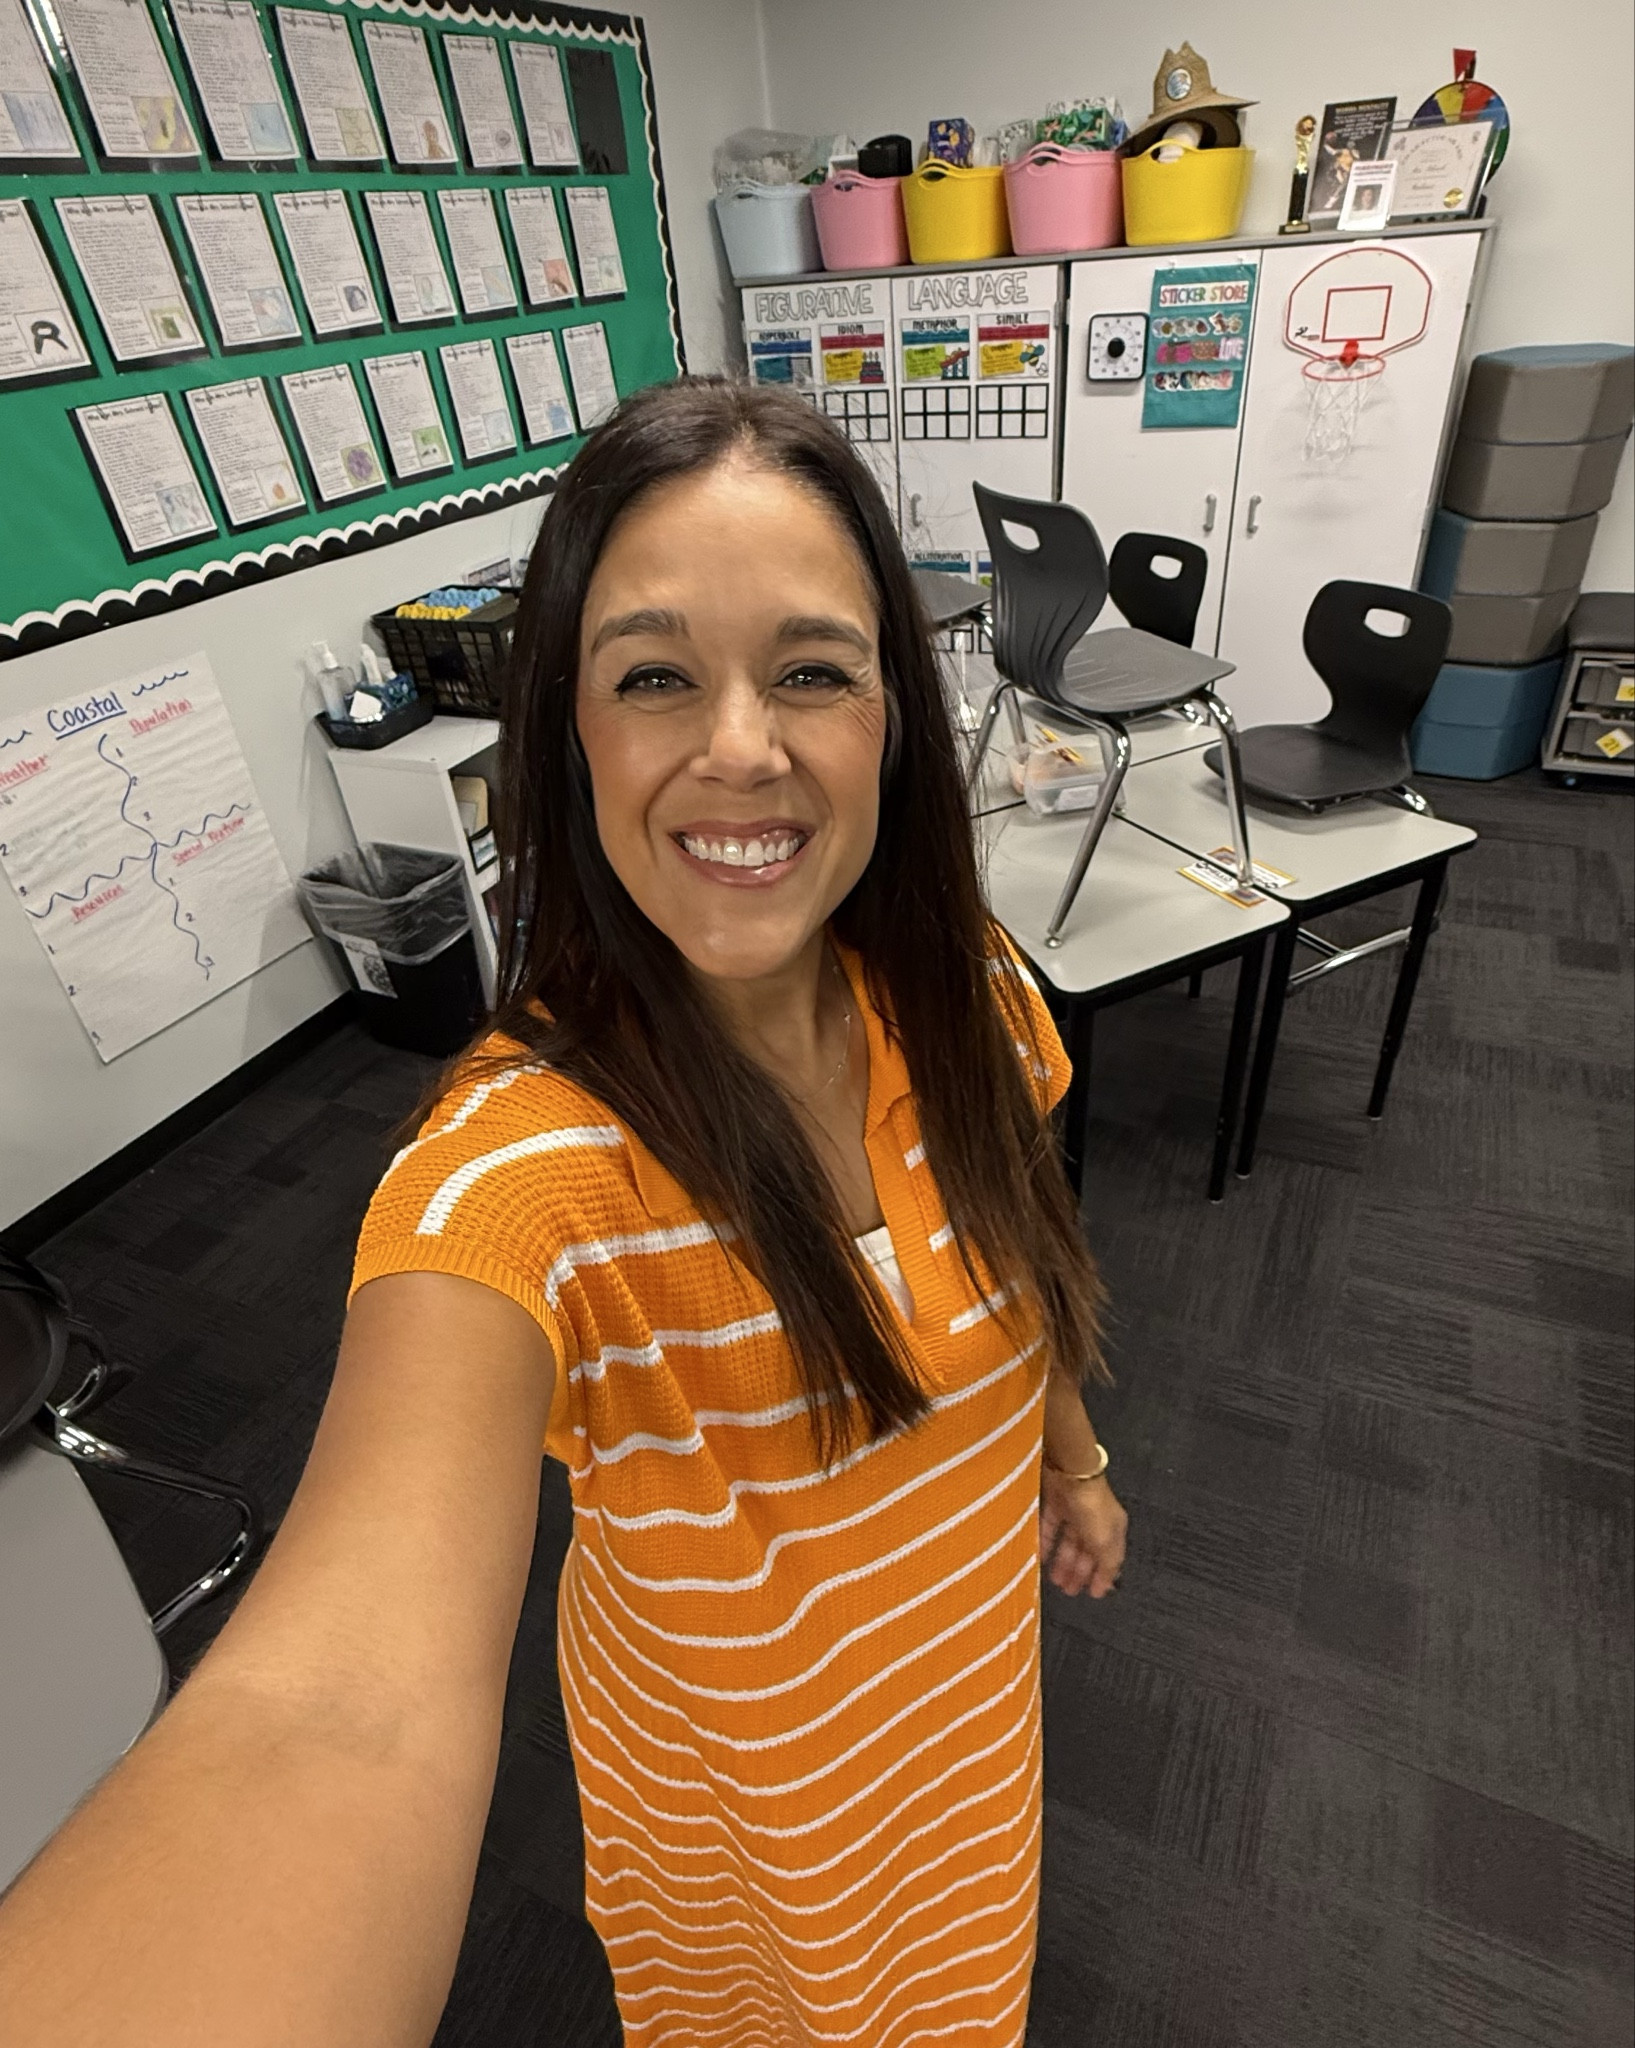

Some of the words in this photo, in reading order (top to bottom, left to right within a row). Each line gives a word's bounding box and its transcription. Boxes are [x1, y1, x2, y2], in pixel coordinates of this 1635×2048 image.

[755, 284, 874, 322] FIGURATIVE
[908, 272, 1029, 311] LANGUAGE
[1161, 288, 1206, 305] STICKER
[1210, 285, 1247, 301] STORE
[838, 324, 864, 335] IDIOM
[913, 318, 960, 333] METAPHOR
[996, 313, 1029, 327] SIMILE
[47, 691, 125, 733] Coastal
[129, 698, 192, 735] Population
[0, 753, 48, 787] eather
[68, 985, 77, 997] 2
